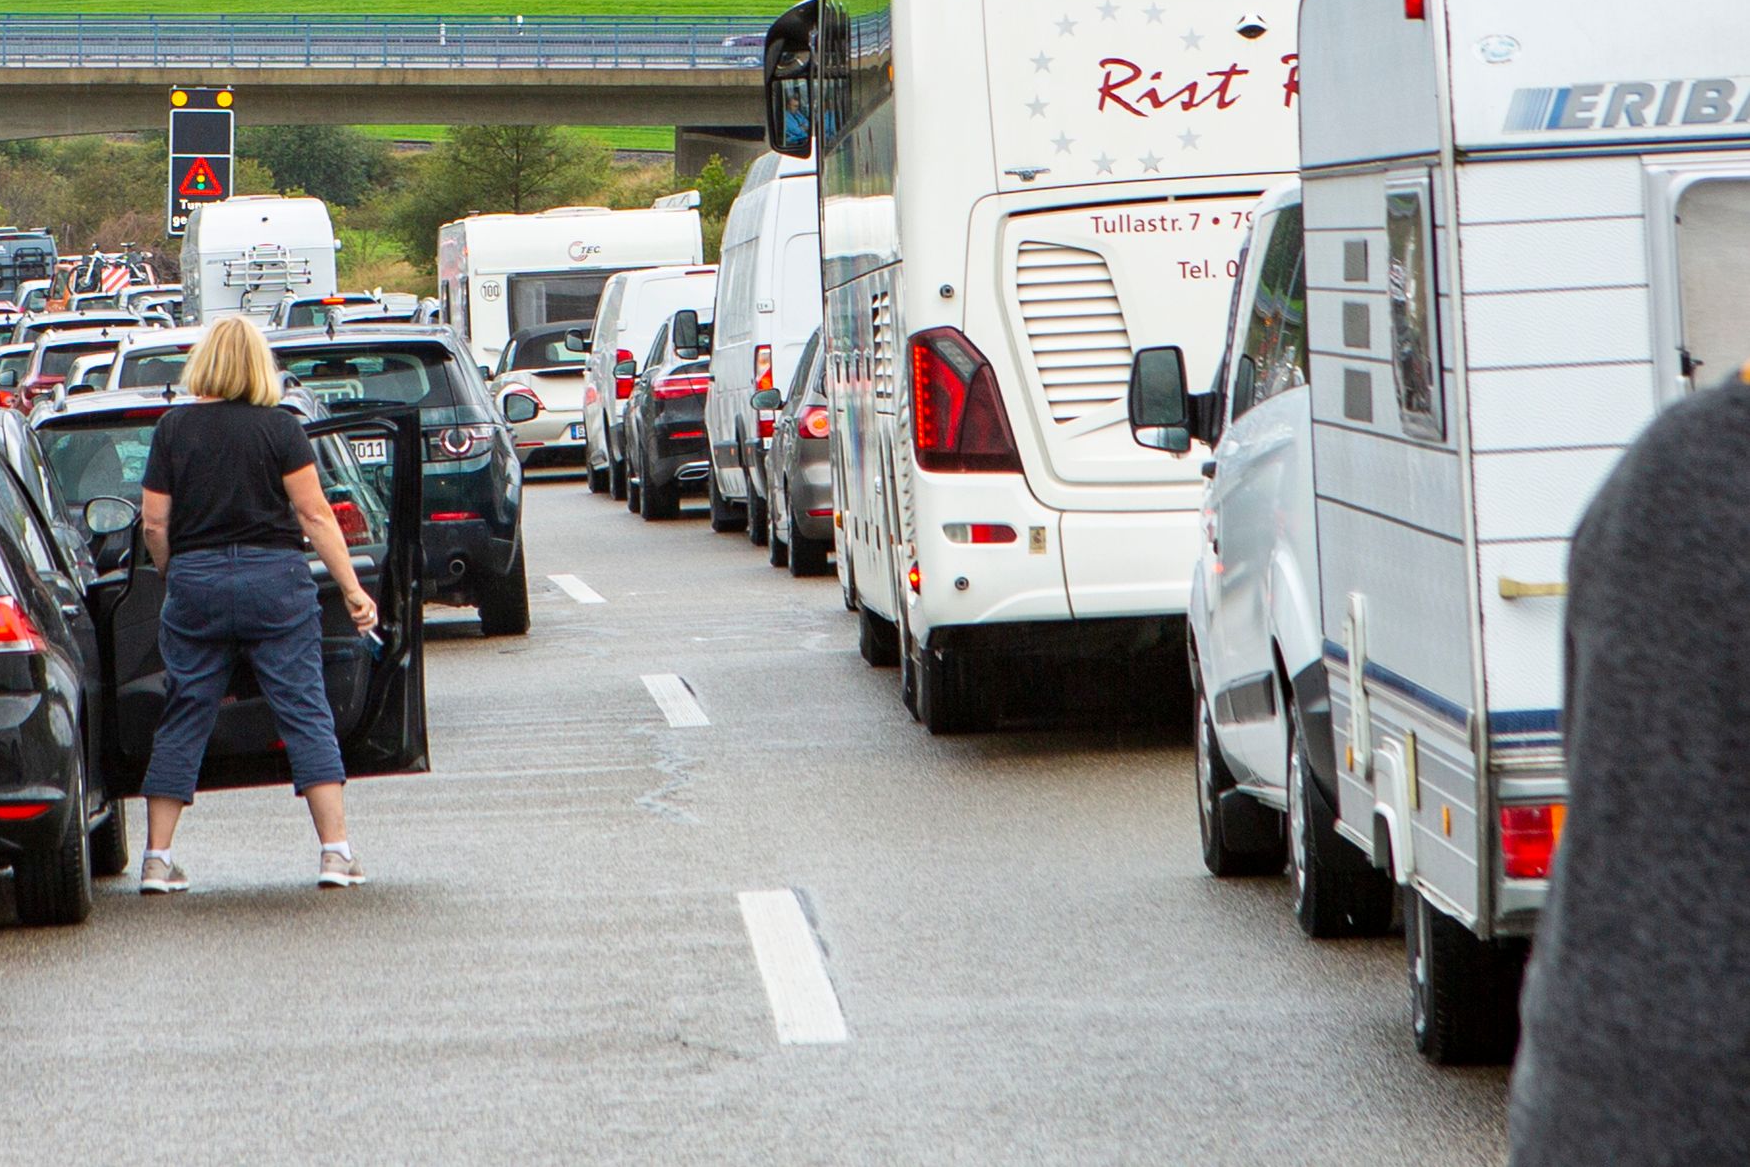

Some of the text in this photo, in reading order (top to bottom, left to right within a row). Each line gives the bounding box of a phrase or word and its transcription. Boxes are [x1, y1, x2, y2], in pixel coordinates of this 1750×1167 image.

[1097, 58, 1250, 117] Rist
[1090, 214, 1183, 234] Tullastr.
[1189, 213, 1201, 231] 7
[1177, 260, 1217, 279] Tel.
[481, 284, 500, 298] 100
